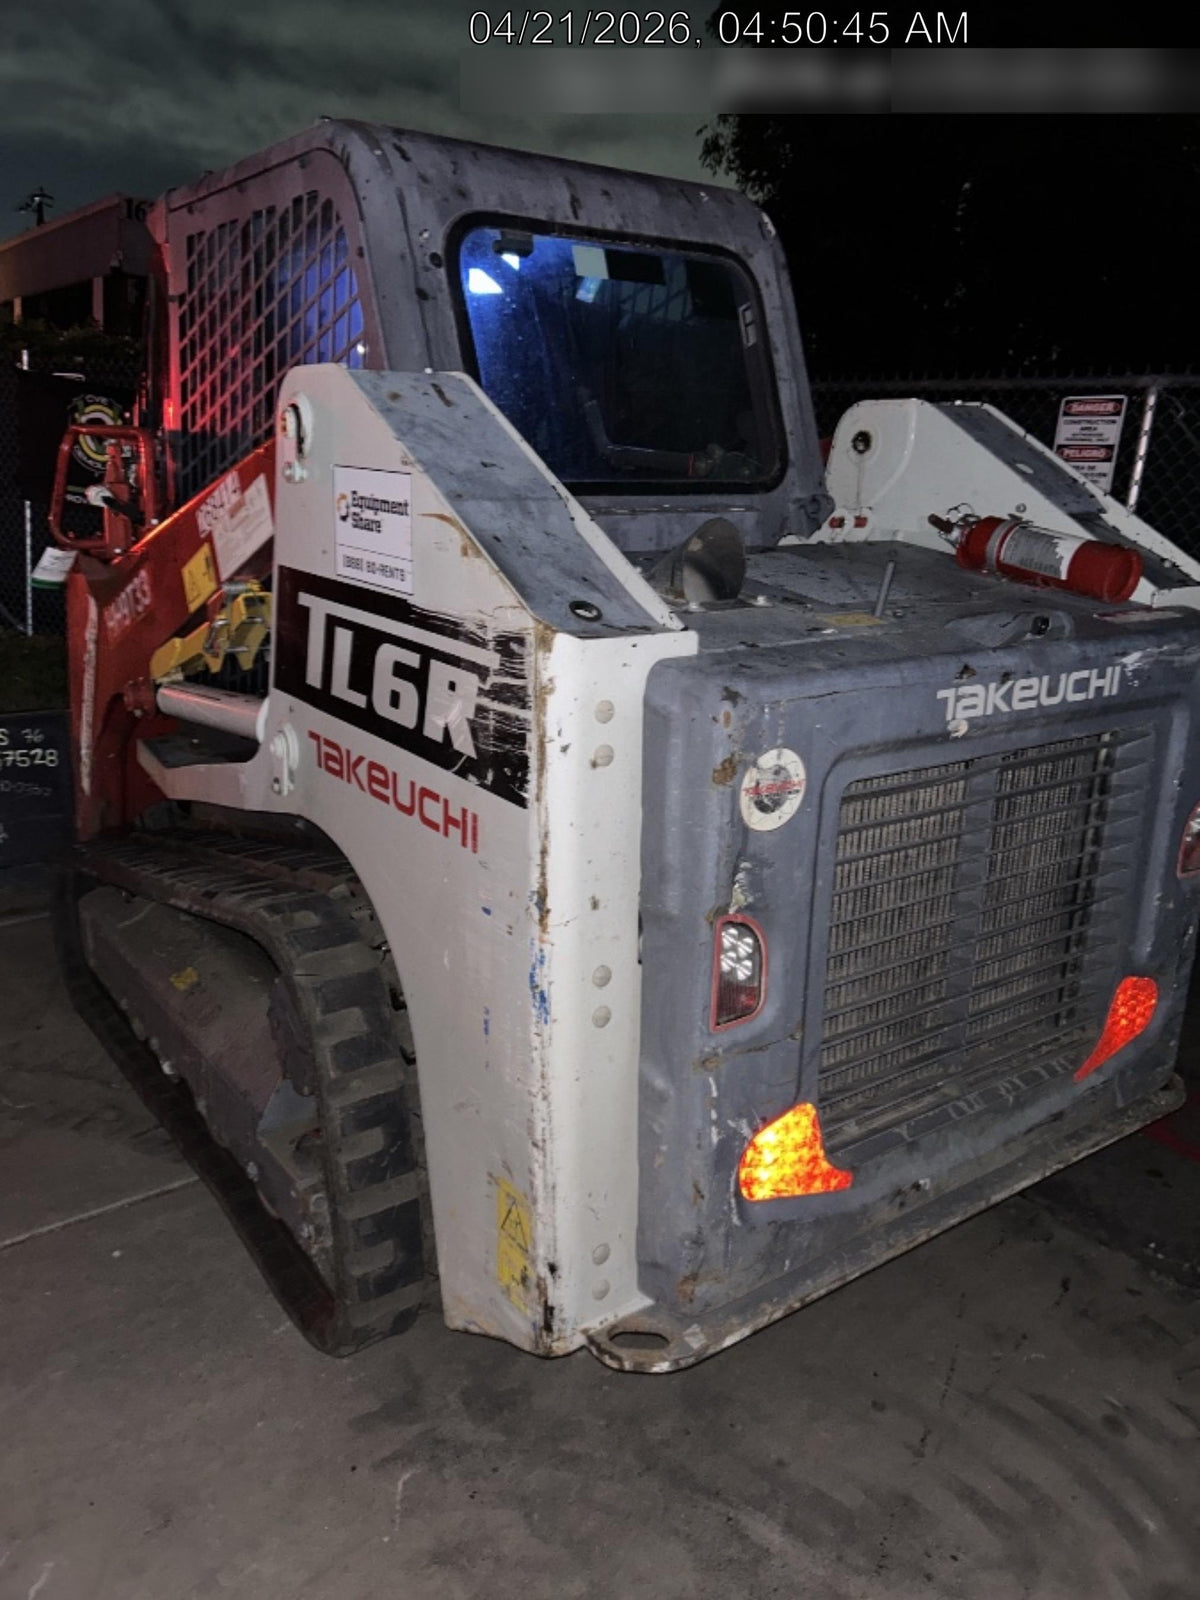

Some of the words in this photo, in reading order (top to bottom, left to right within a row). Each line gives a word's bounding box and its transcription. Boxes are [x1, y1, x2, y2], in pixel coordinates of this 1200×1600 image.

[1069, 401, 1117, 412] DANGER
[1063, 447, 1107, 458] PELIGRO
[351, 490, 409, 516] Equipment
[351, 511, 382, 533] Share
[298, 591, 500, 760] TL6R
[0, 748, 59, 768] 7528
